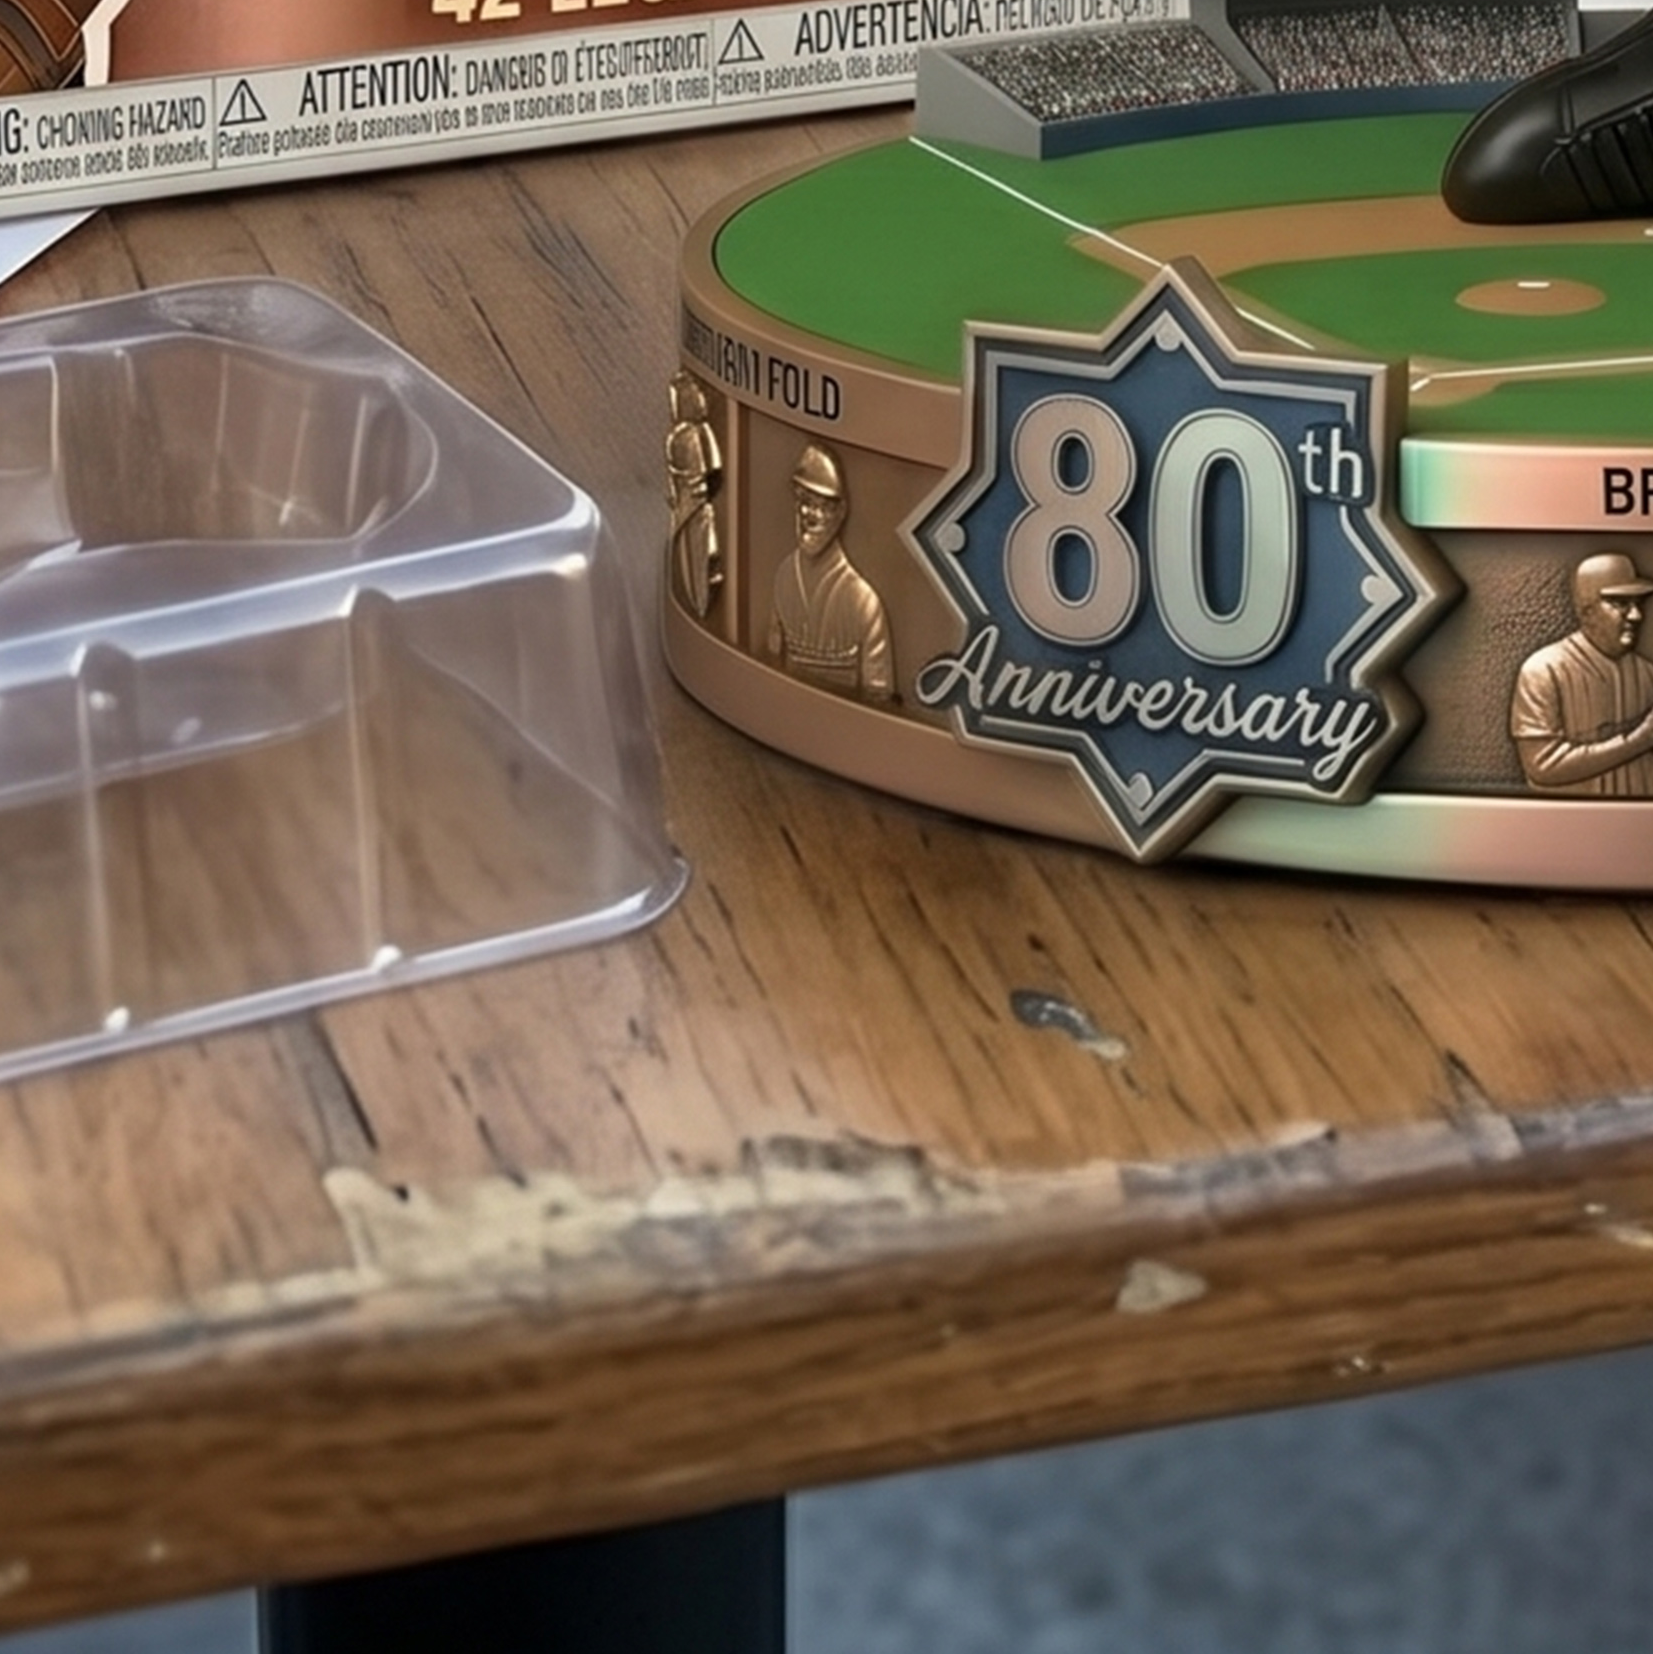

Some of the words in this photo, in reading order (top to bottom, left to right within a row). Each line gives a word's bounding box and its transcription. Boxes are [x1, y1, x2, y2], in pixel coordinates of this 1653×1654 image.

[298, 53, 458, 117] ATTENTION:
[767, 356, 841, 422] FOLD
[918, 625, 1378, 782] Anniversary
